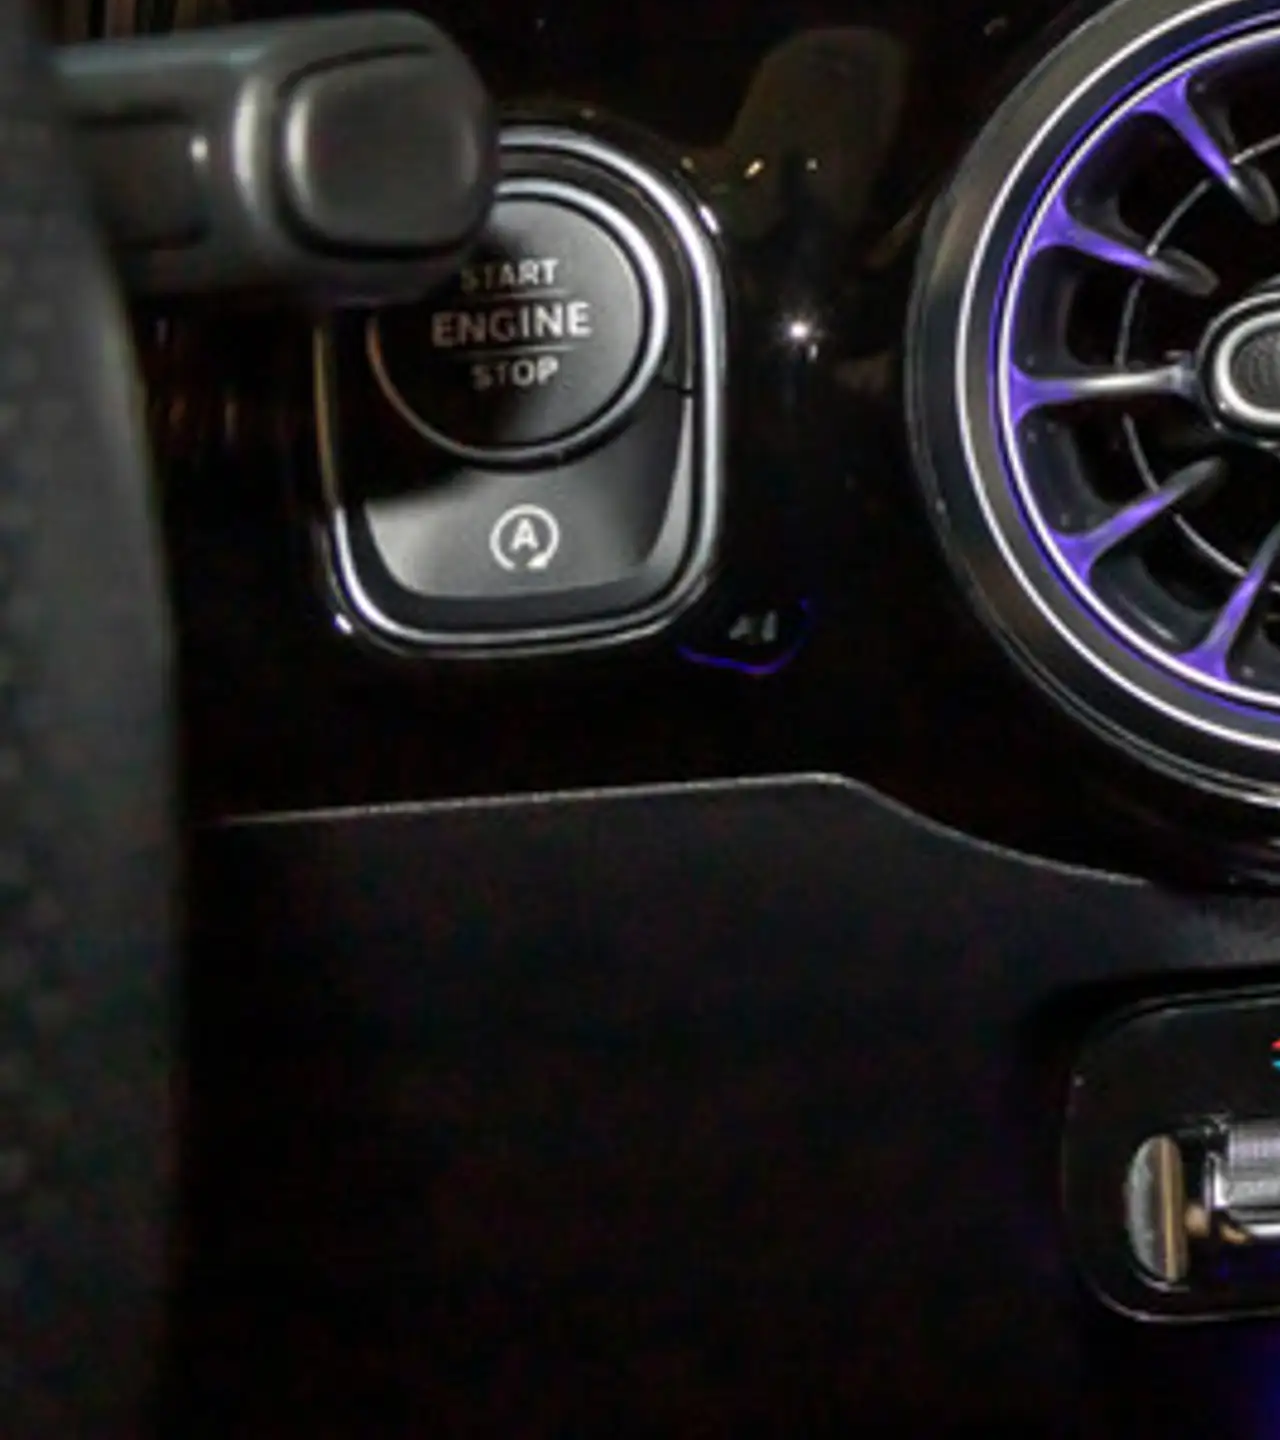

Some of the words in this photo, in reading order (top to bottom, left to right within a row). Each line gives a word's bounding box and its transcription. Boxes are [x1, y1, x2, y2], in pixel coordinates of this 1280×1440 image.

[460, 259, 558, 293] START
[432, 301, 592, 347] ENGINE
[472, 358, 559, 390] STOP
[510, 517, 539, 552] A
